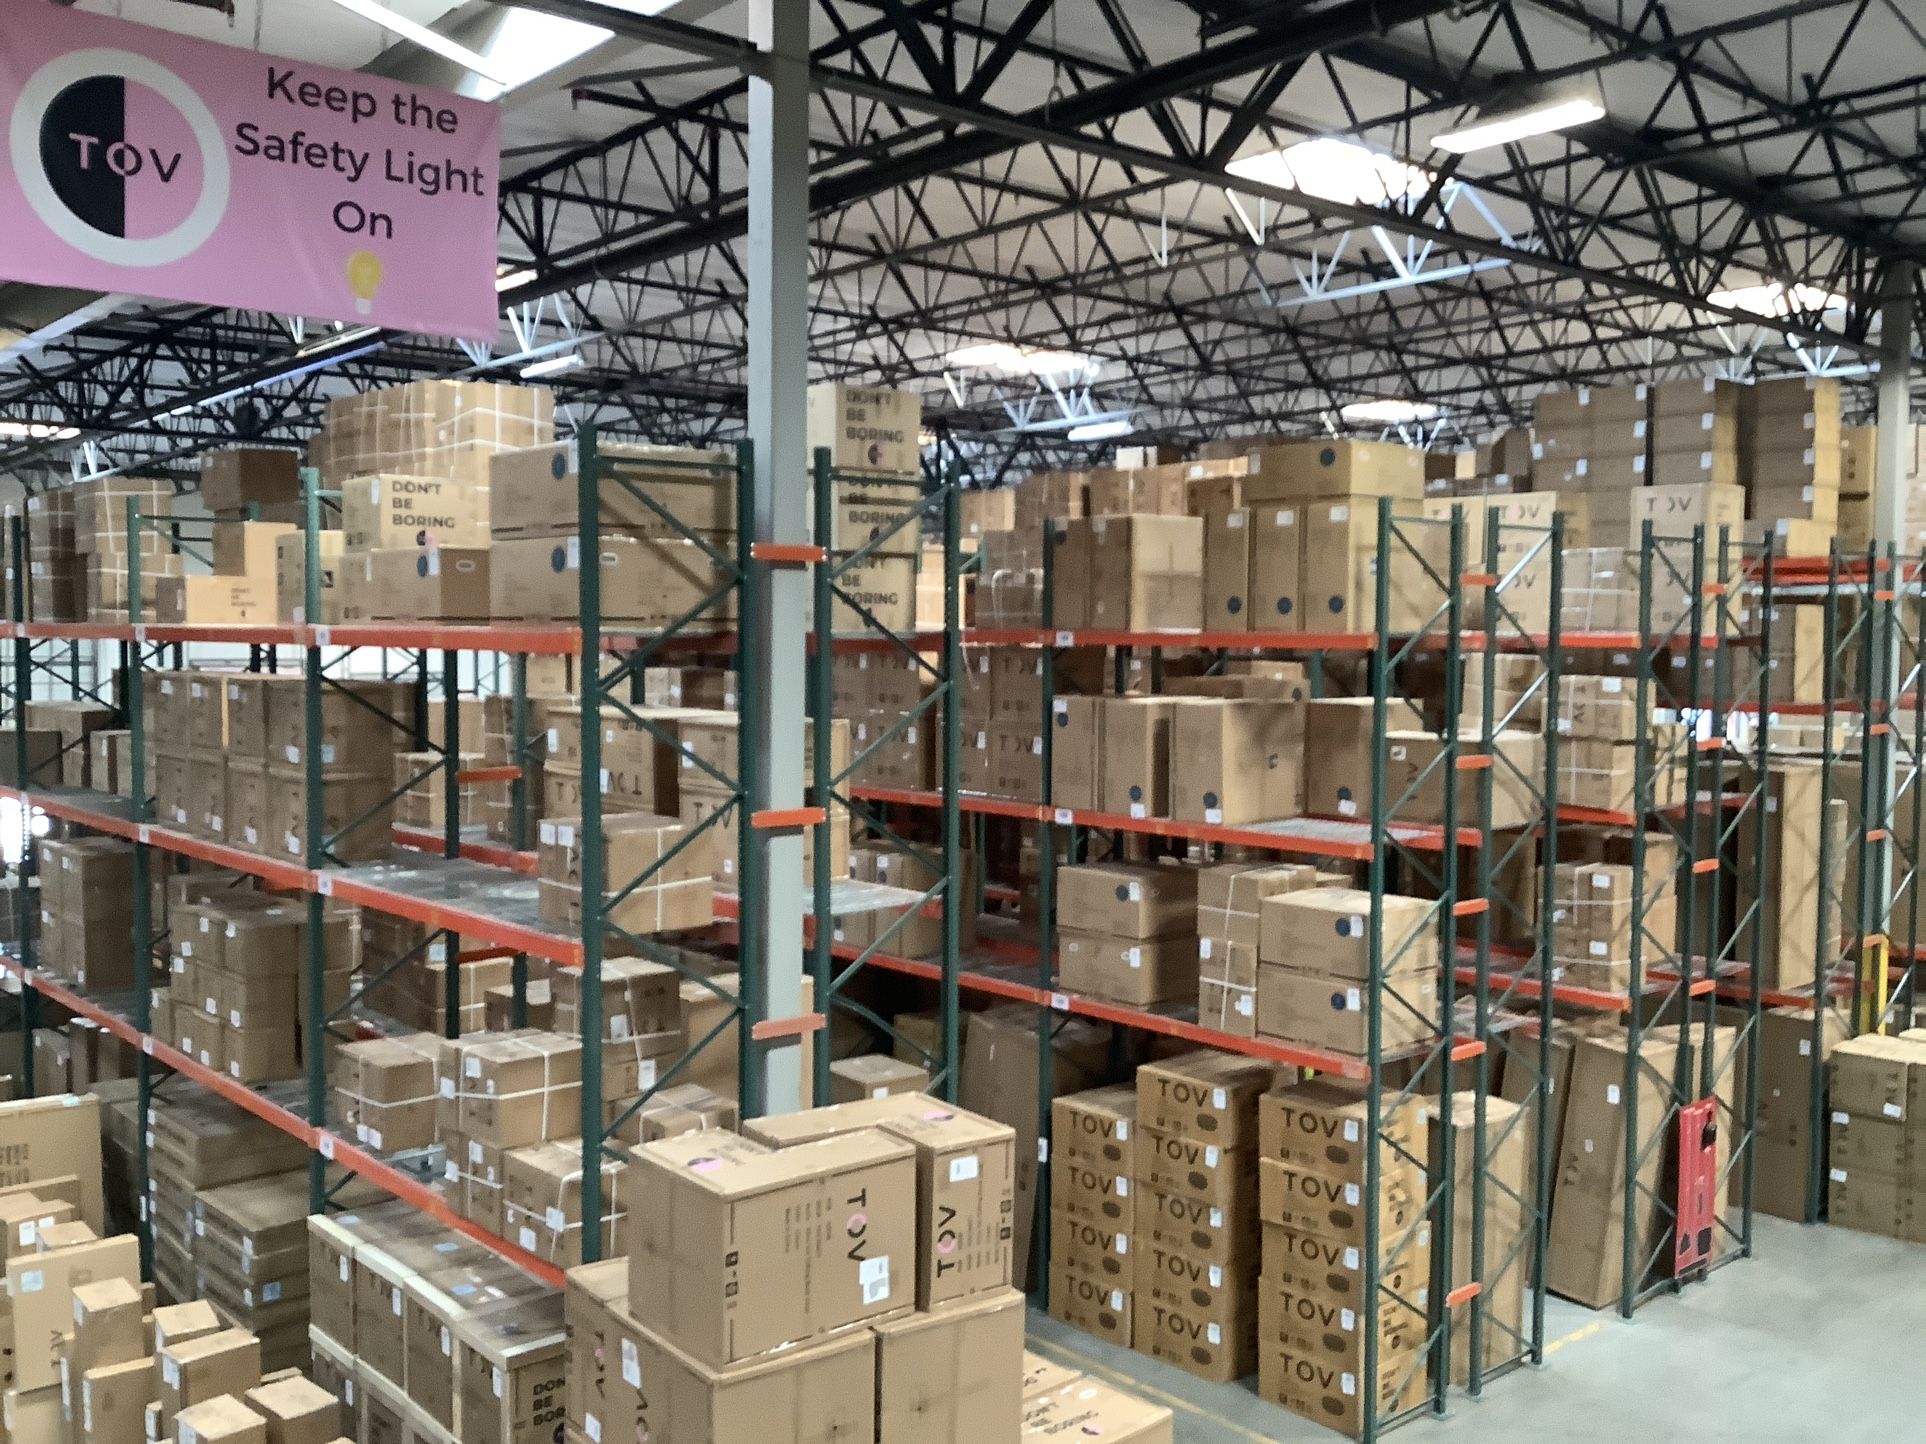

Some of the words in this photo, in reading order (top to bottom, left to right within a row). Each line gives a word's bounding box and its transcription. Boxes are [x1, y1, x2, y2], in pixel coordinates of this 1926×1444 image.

[267, 66, 377, 123] Keep
[392, 92, 458, 134] the
[69, 132, 182, 183] TOV
[234, 122, 369, 183] Safety
[385, 148, 484, 196] Light
[333, 200, 393, 239] On
[846, 407, 866, 422] BE
[846, 426, 904, 443] BORING
[392, 481, 442, 495] DON'T
[392, 497, 413, 509] BE
[392, 514, 456, 528] BORING
[1157, 1077, 1208, 1107] TOV
[1069, 1110, 1113, 1138] TOV
[1281, 1107, 1338, 1137] TOV
[1152, 1134, 1199, 1165] TOV
[1068, 1165, 1112, 1194] TOV
[1282, 1169, 1341, 1202] TOV
[1155, 1192, 1202, 1224] TOV
[847, 1188, 867, 1261] TOV
[1068, 1220, 1112, 1250] TOV
[937, 1205, 957, 1278] TOV
[1284, 1232, 1340, 1266] TOV
[1153, 1250, 1201, 1282] TOV
[1065, 1274, 1109, 1306] TOV
[1153, 1306, 1202, 1340] TOV
[1280, 1291, 1335, 1326] TOV
[1280, 1353, 1334, 1388] TOV
[533, 1378, 565, 1395] DON
[533, 1396, 553, 1411] BE
[533, 1406, 566, 1426] BOR
